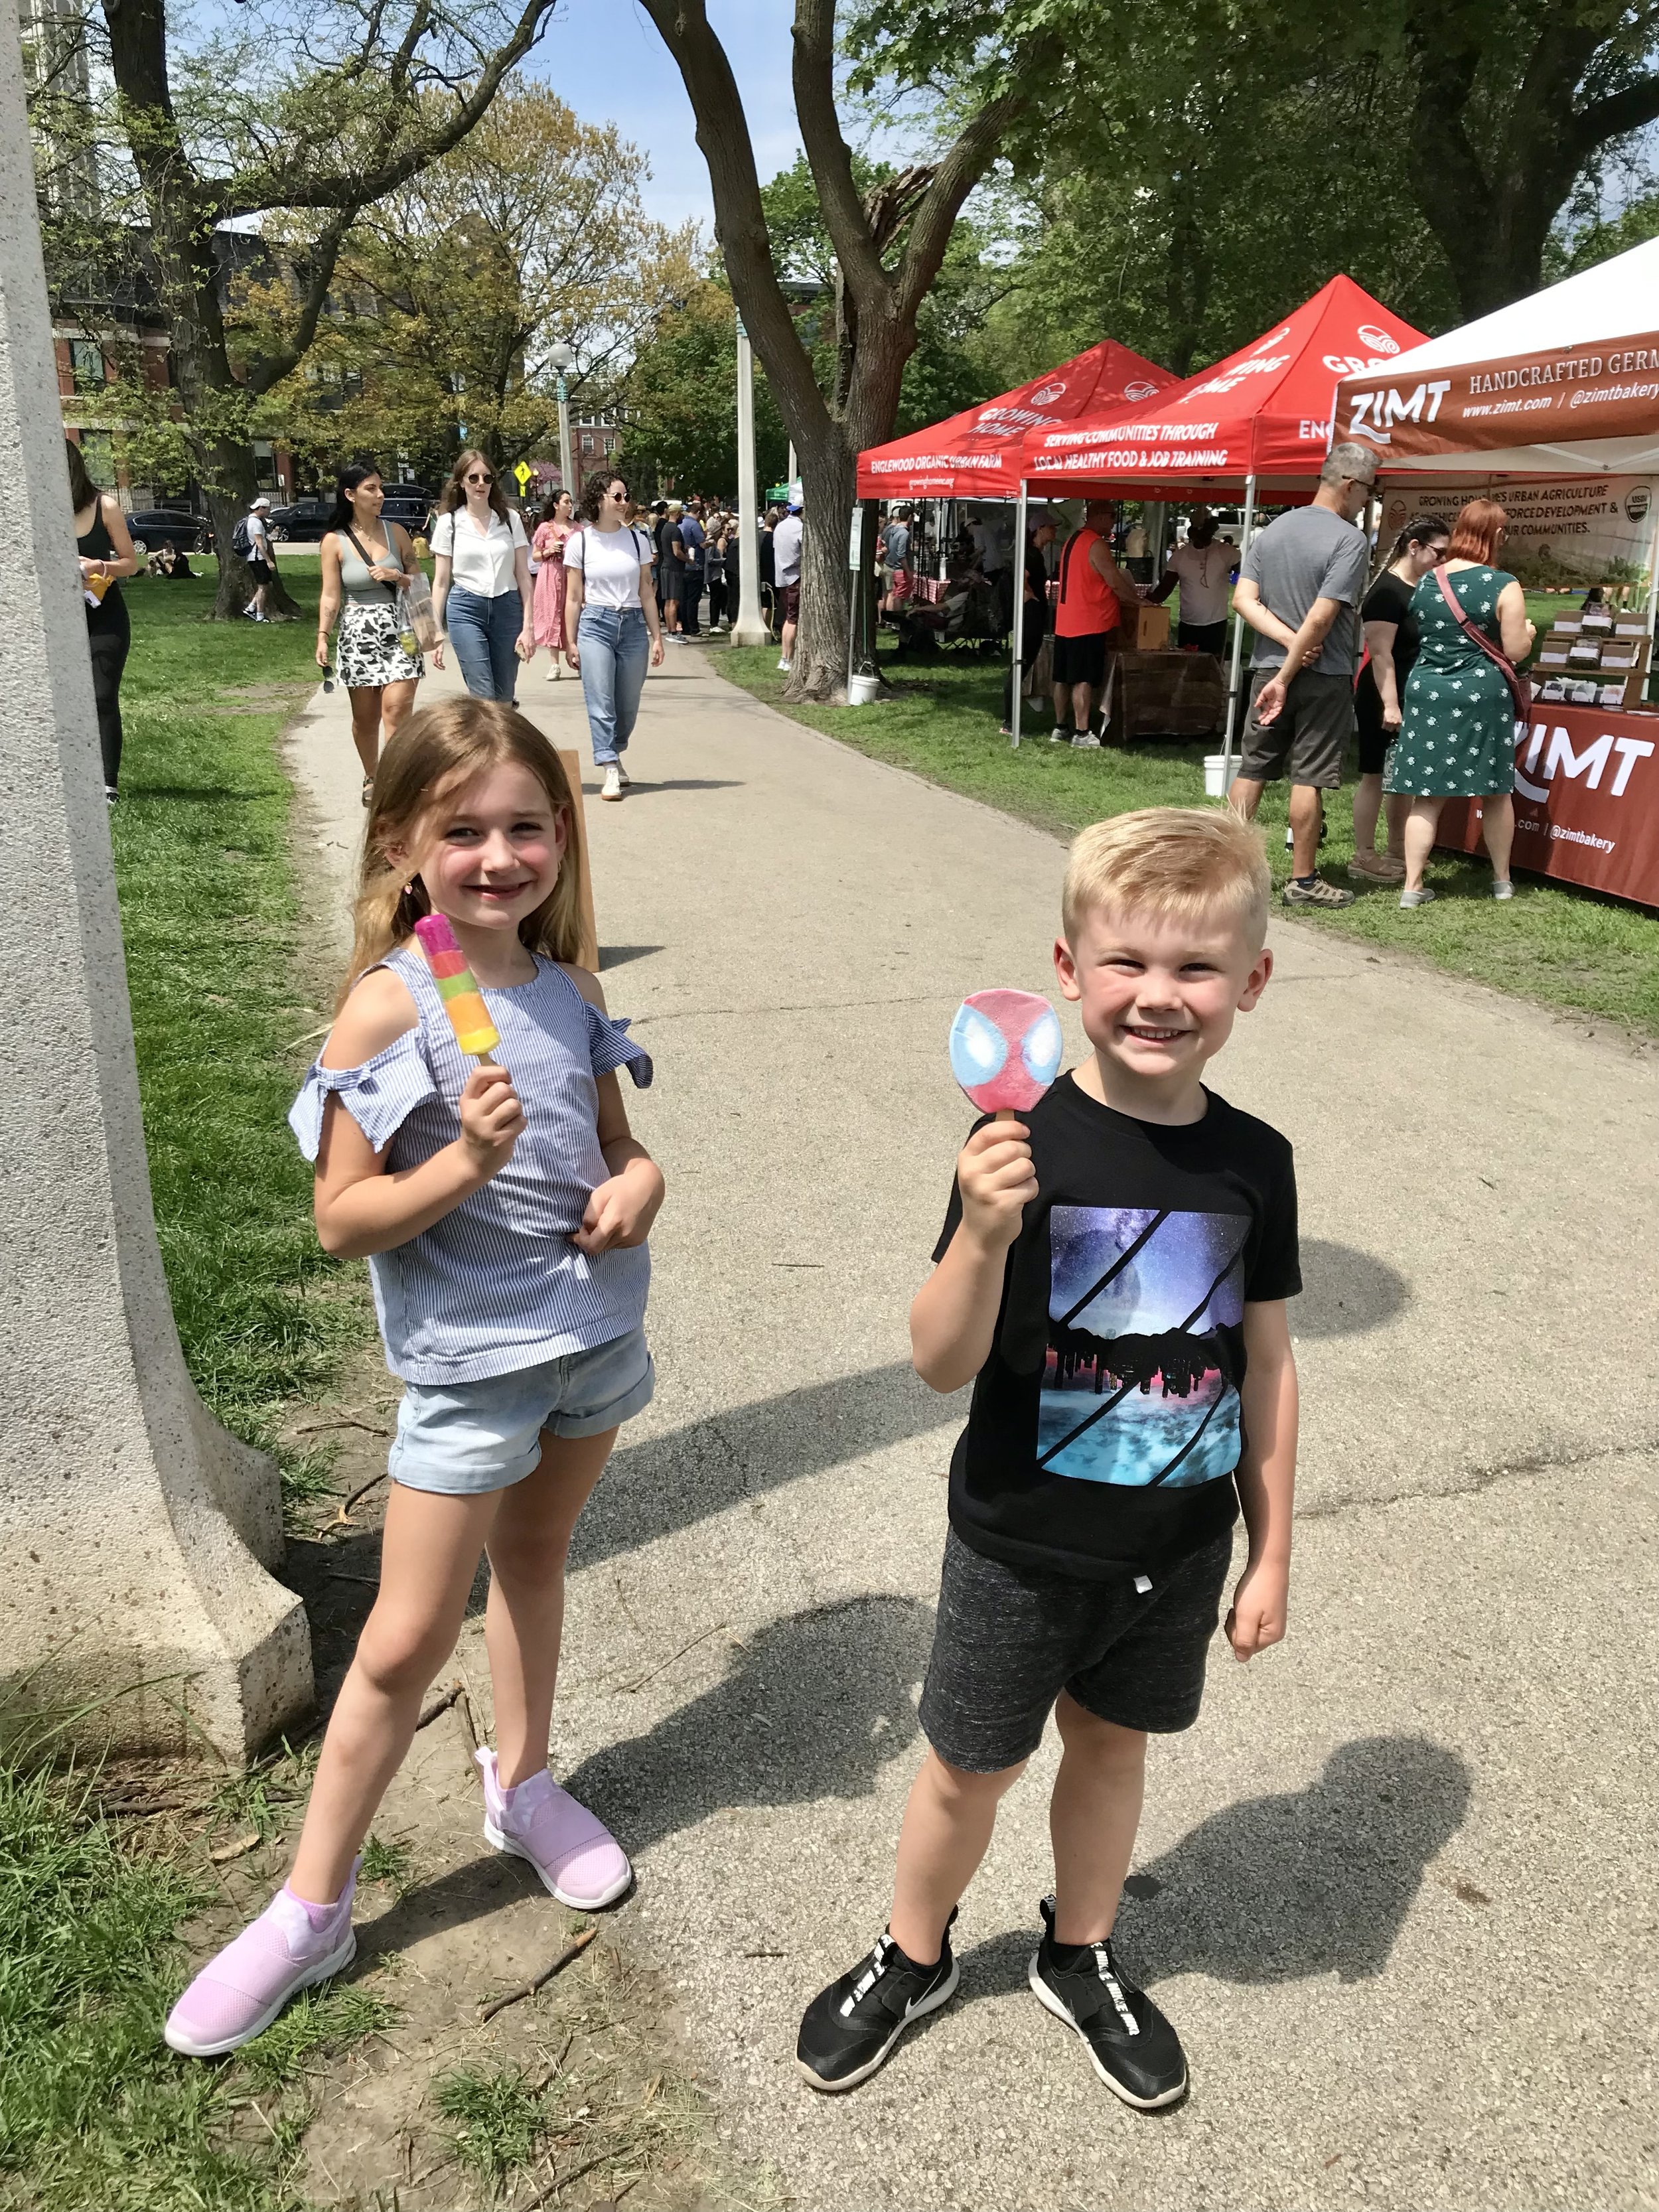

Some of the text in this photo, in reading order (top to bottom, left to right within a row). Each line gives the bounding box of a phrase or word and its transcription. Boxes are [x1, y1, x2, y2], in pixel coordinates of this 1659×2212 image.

[1469, 357, 1603, 394] HANDCRAFTED
[1348, 380, 1451, 444] ZIMT
[1463, 397, 1552, 418] www.zimt.com
[1570, 382, 1659, 409] @zimtbakery
[968, 423, 1025, 437] HOME
[1044, 422, 1219, 447] SERVING COMMUNITIES THROUGH
[871, 453, 1003, 474] ENGLEWOOD ORGANIC URBAN FARM
[1034, 449, 1228, 471] LOCAL HEALTHY FOOD & JOB TRAINING
[1419, 496, 1460, 507] GROWING
[1508, 490, 1540, 502] URBAN
[1542, 484, 1609, 500] AGRICULTURE
[1536, 502, 1607, 518] DEVELOPMENT
[1610, 501, 1619, 514] &
[1521, 522, 1591, 536] COMMUNITIES.
[1550, 824, 1616, 854] @zimtbakery
[1106, 1982, 1129, 2012] NIKE
